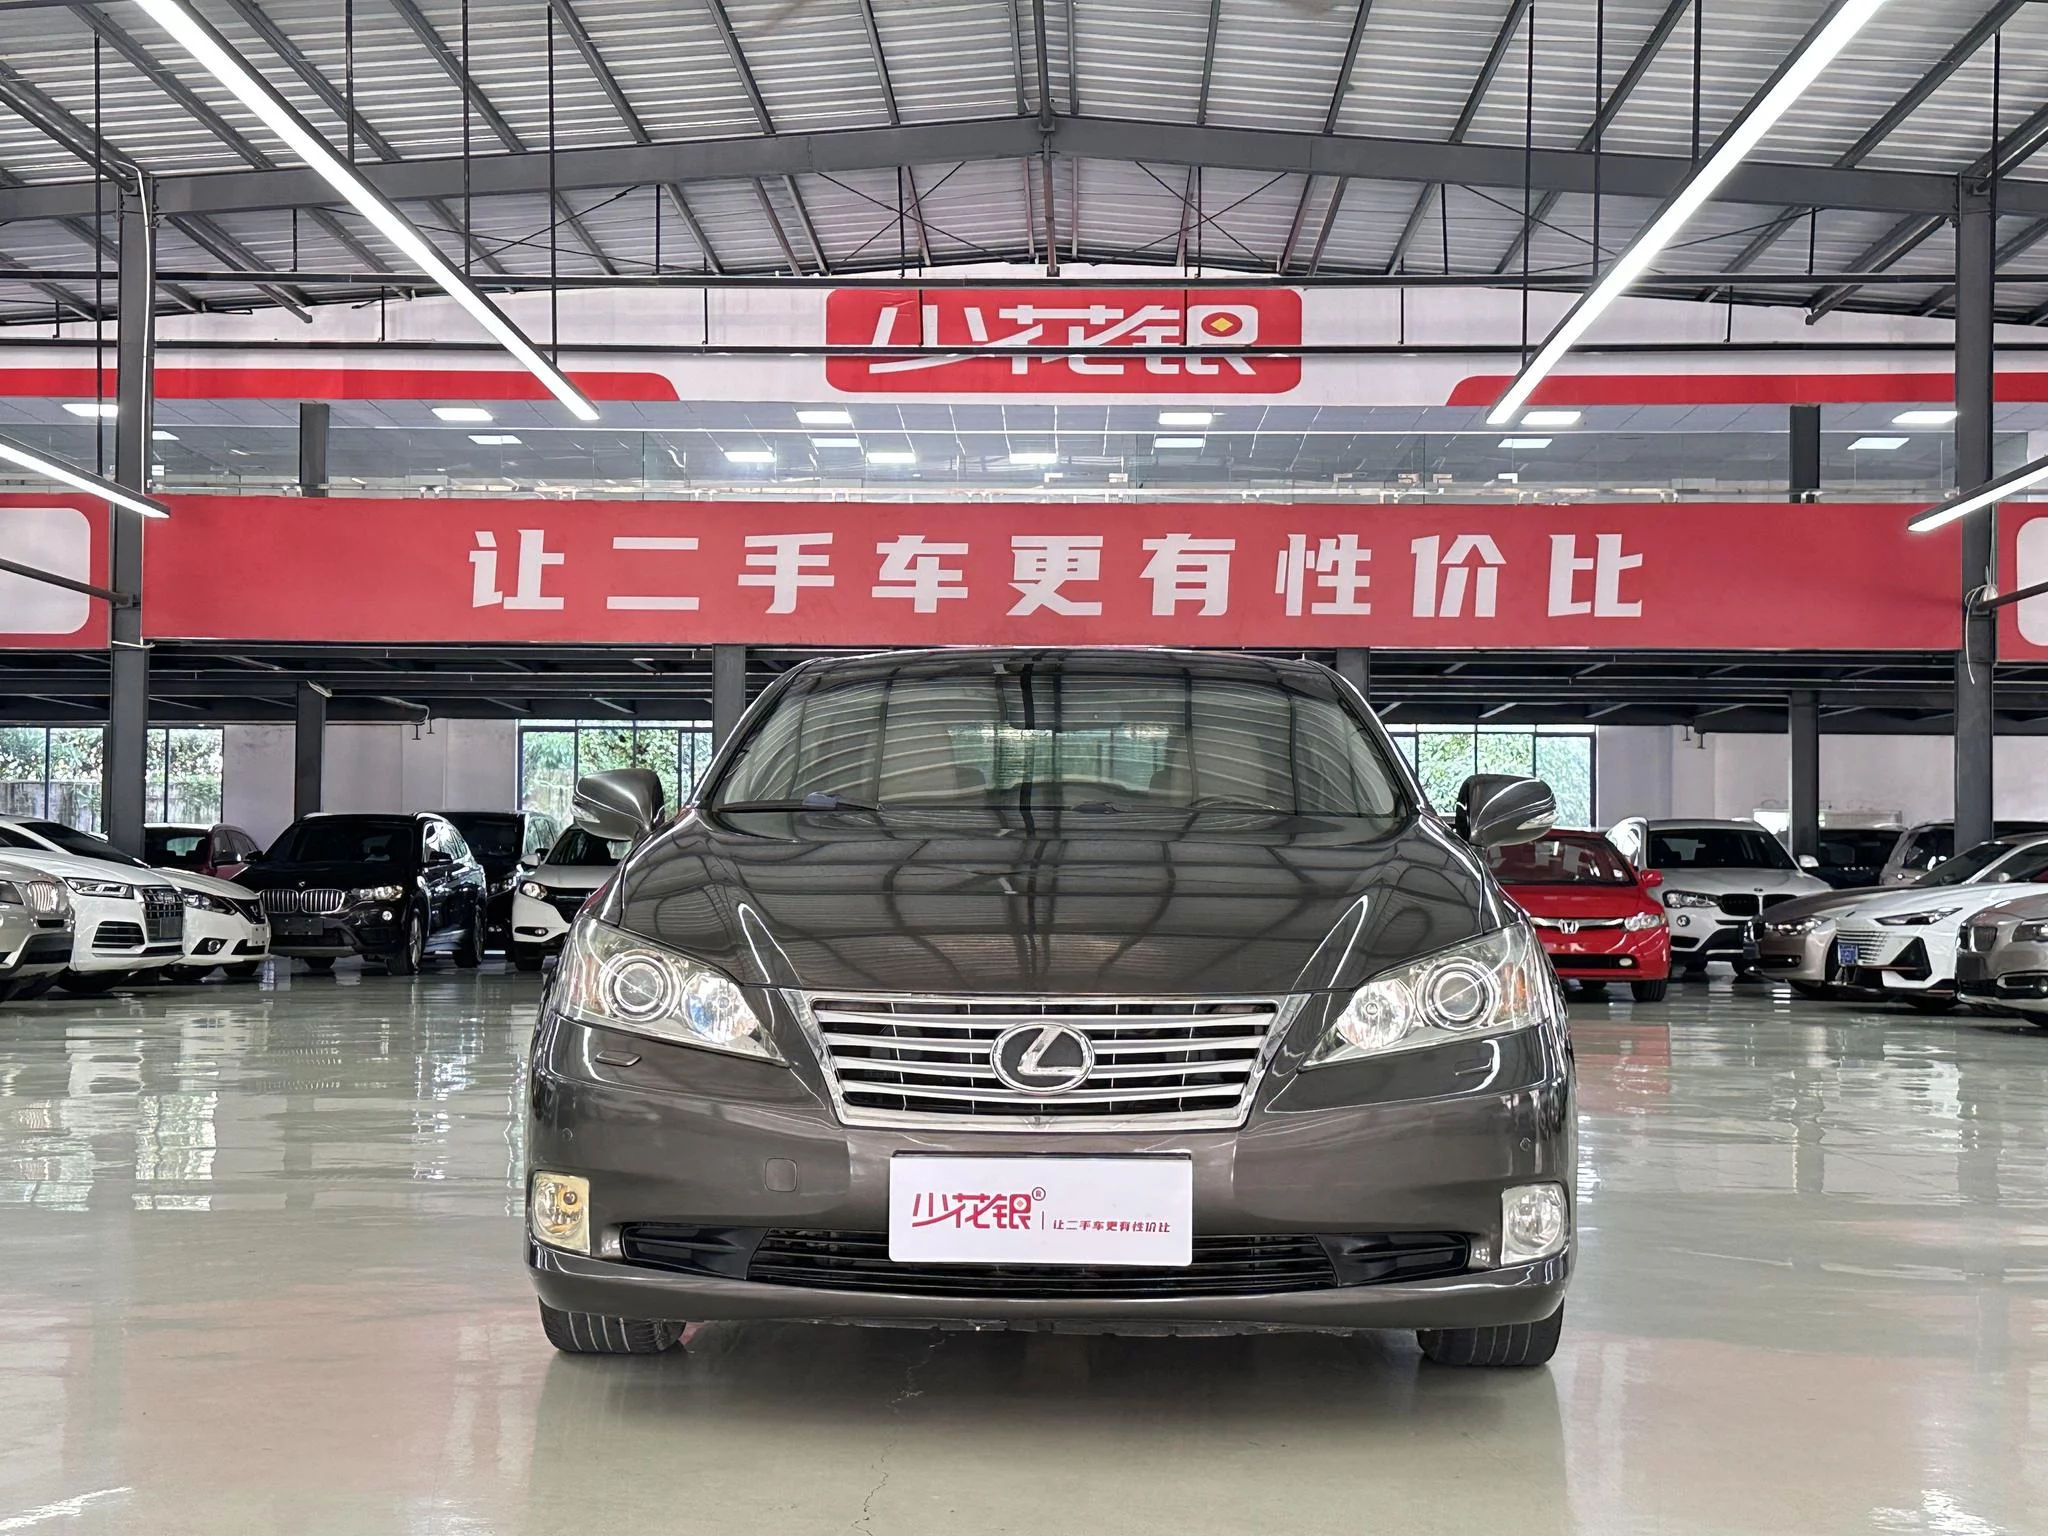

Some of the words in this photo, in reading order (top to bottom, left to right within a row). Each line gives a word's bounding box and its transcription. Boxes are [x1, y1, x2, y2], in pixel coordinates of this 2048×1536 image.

[868, 303, 1258, 375] 少花银
[468, 529, 1643, 618] 让二手车更有性价比
[1052, 1219, 1170, 1233] 让二手车更有性价比
